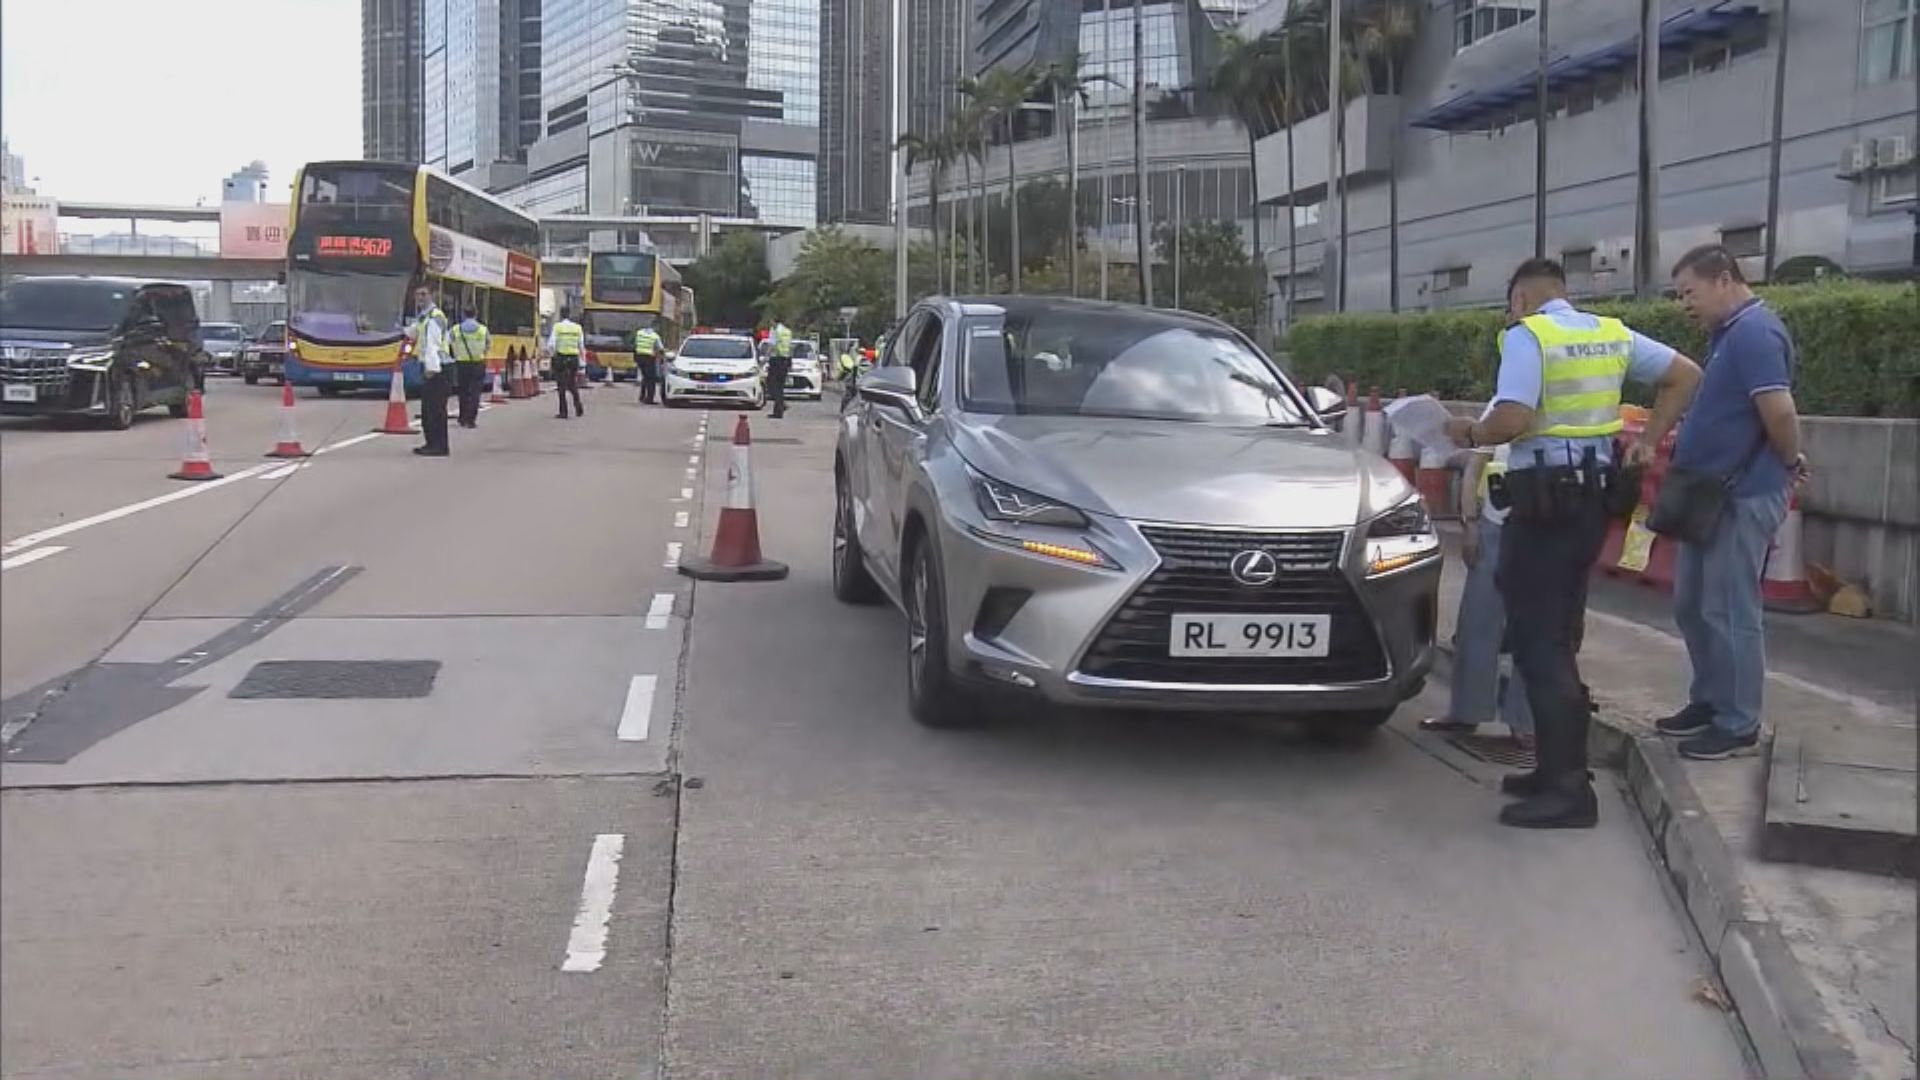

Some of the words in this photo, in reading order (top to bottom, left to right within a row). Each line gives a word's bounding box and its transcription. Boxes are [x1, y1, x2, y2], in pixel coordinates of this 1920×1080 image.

[638, 143, 662, 161] W
[361, 238, 392, 256] 962P
[1577, 343, 1608, 357] POLICE
[1184, 622, 1227, 649] RL
[1242, 622, 1317, 649] 9913
